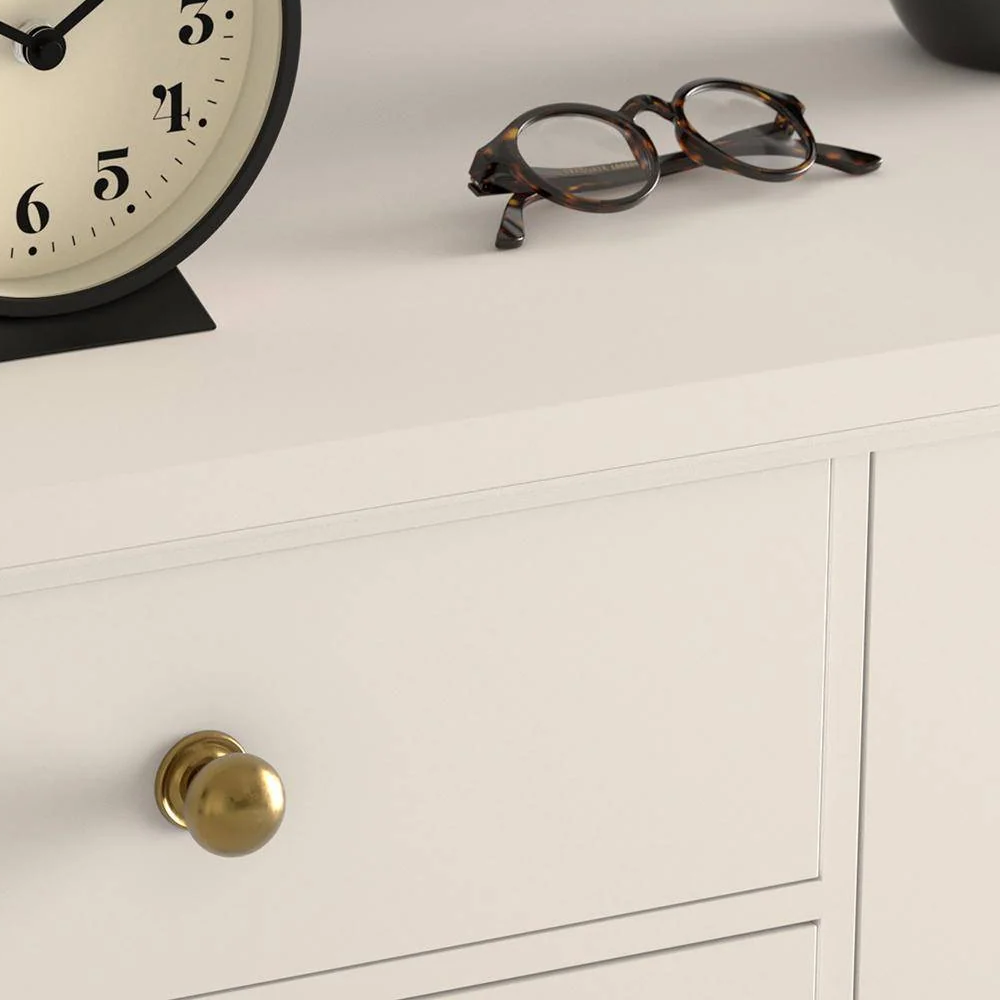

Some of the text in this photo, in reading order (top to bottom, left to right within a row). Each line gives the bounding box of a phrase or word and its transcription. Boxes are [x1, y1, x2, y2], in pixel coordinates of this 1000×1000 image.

[152, 81, 191, 134] 4
[93, 146, 130, 201] 5
[15, 182, 51, 235] 6
